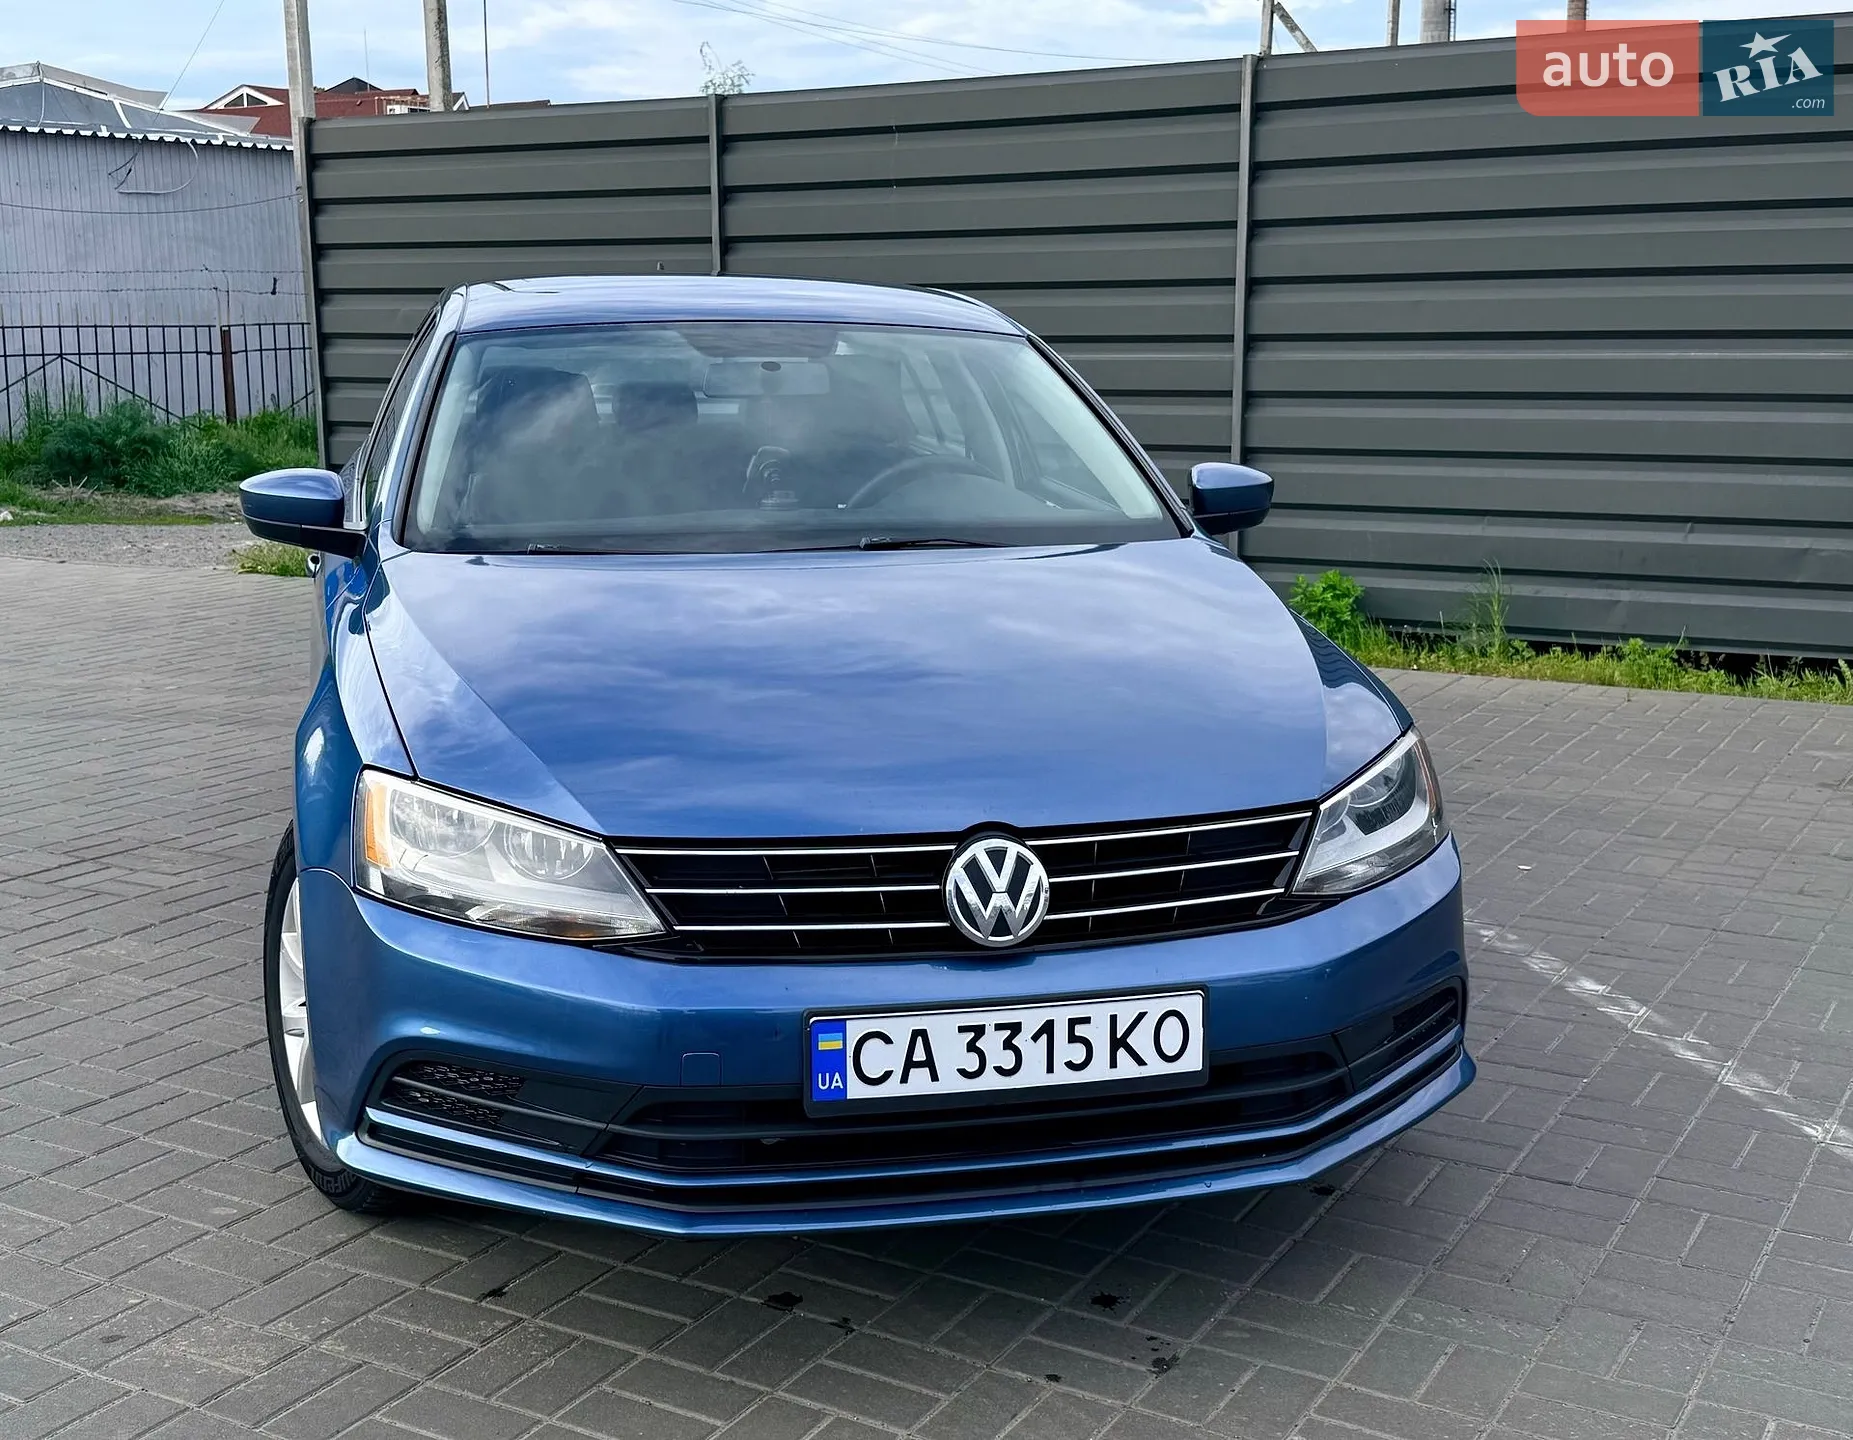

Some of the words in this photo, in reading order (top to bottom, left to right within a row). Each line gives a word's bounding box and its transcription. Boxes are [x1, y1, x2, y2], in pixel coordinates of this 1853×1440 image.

[951, 841, 1045, 943] VW
[818, 1073, 844, 1090] UA
[852, 1028, 940, 1086] CA
[956, 1016, 1095, 1079] 3315
[1109, 1009, 1190, 1069] KO
